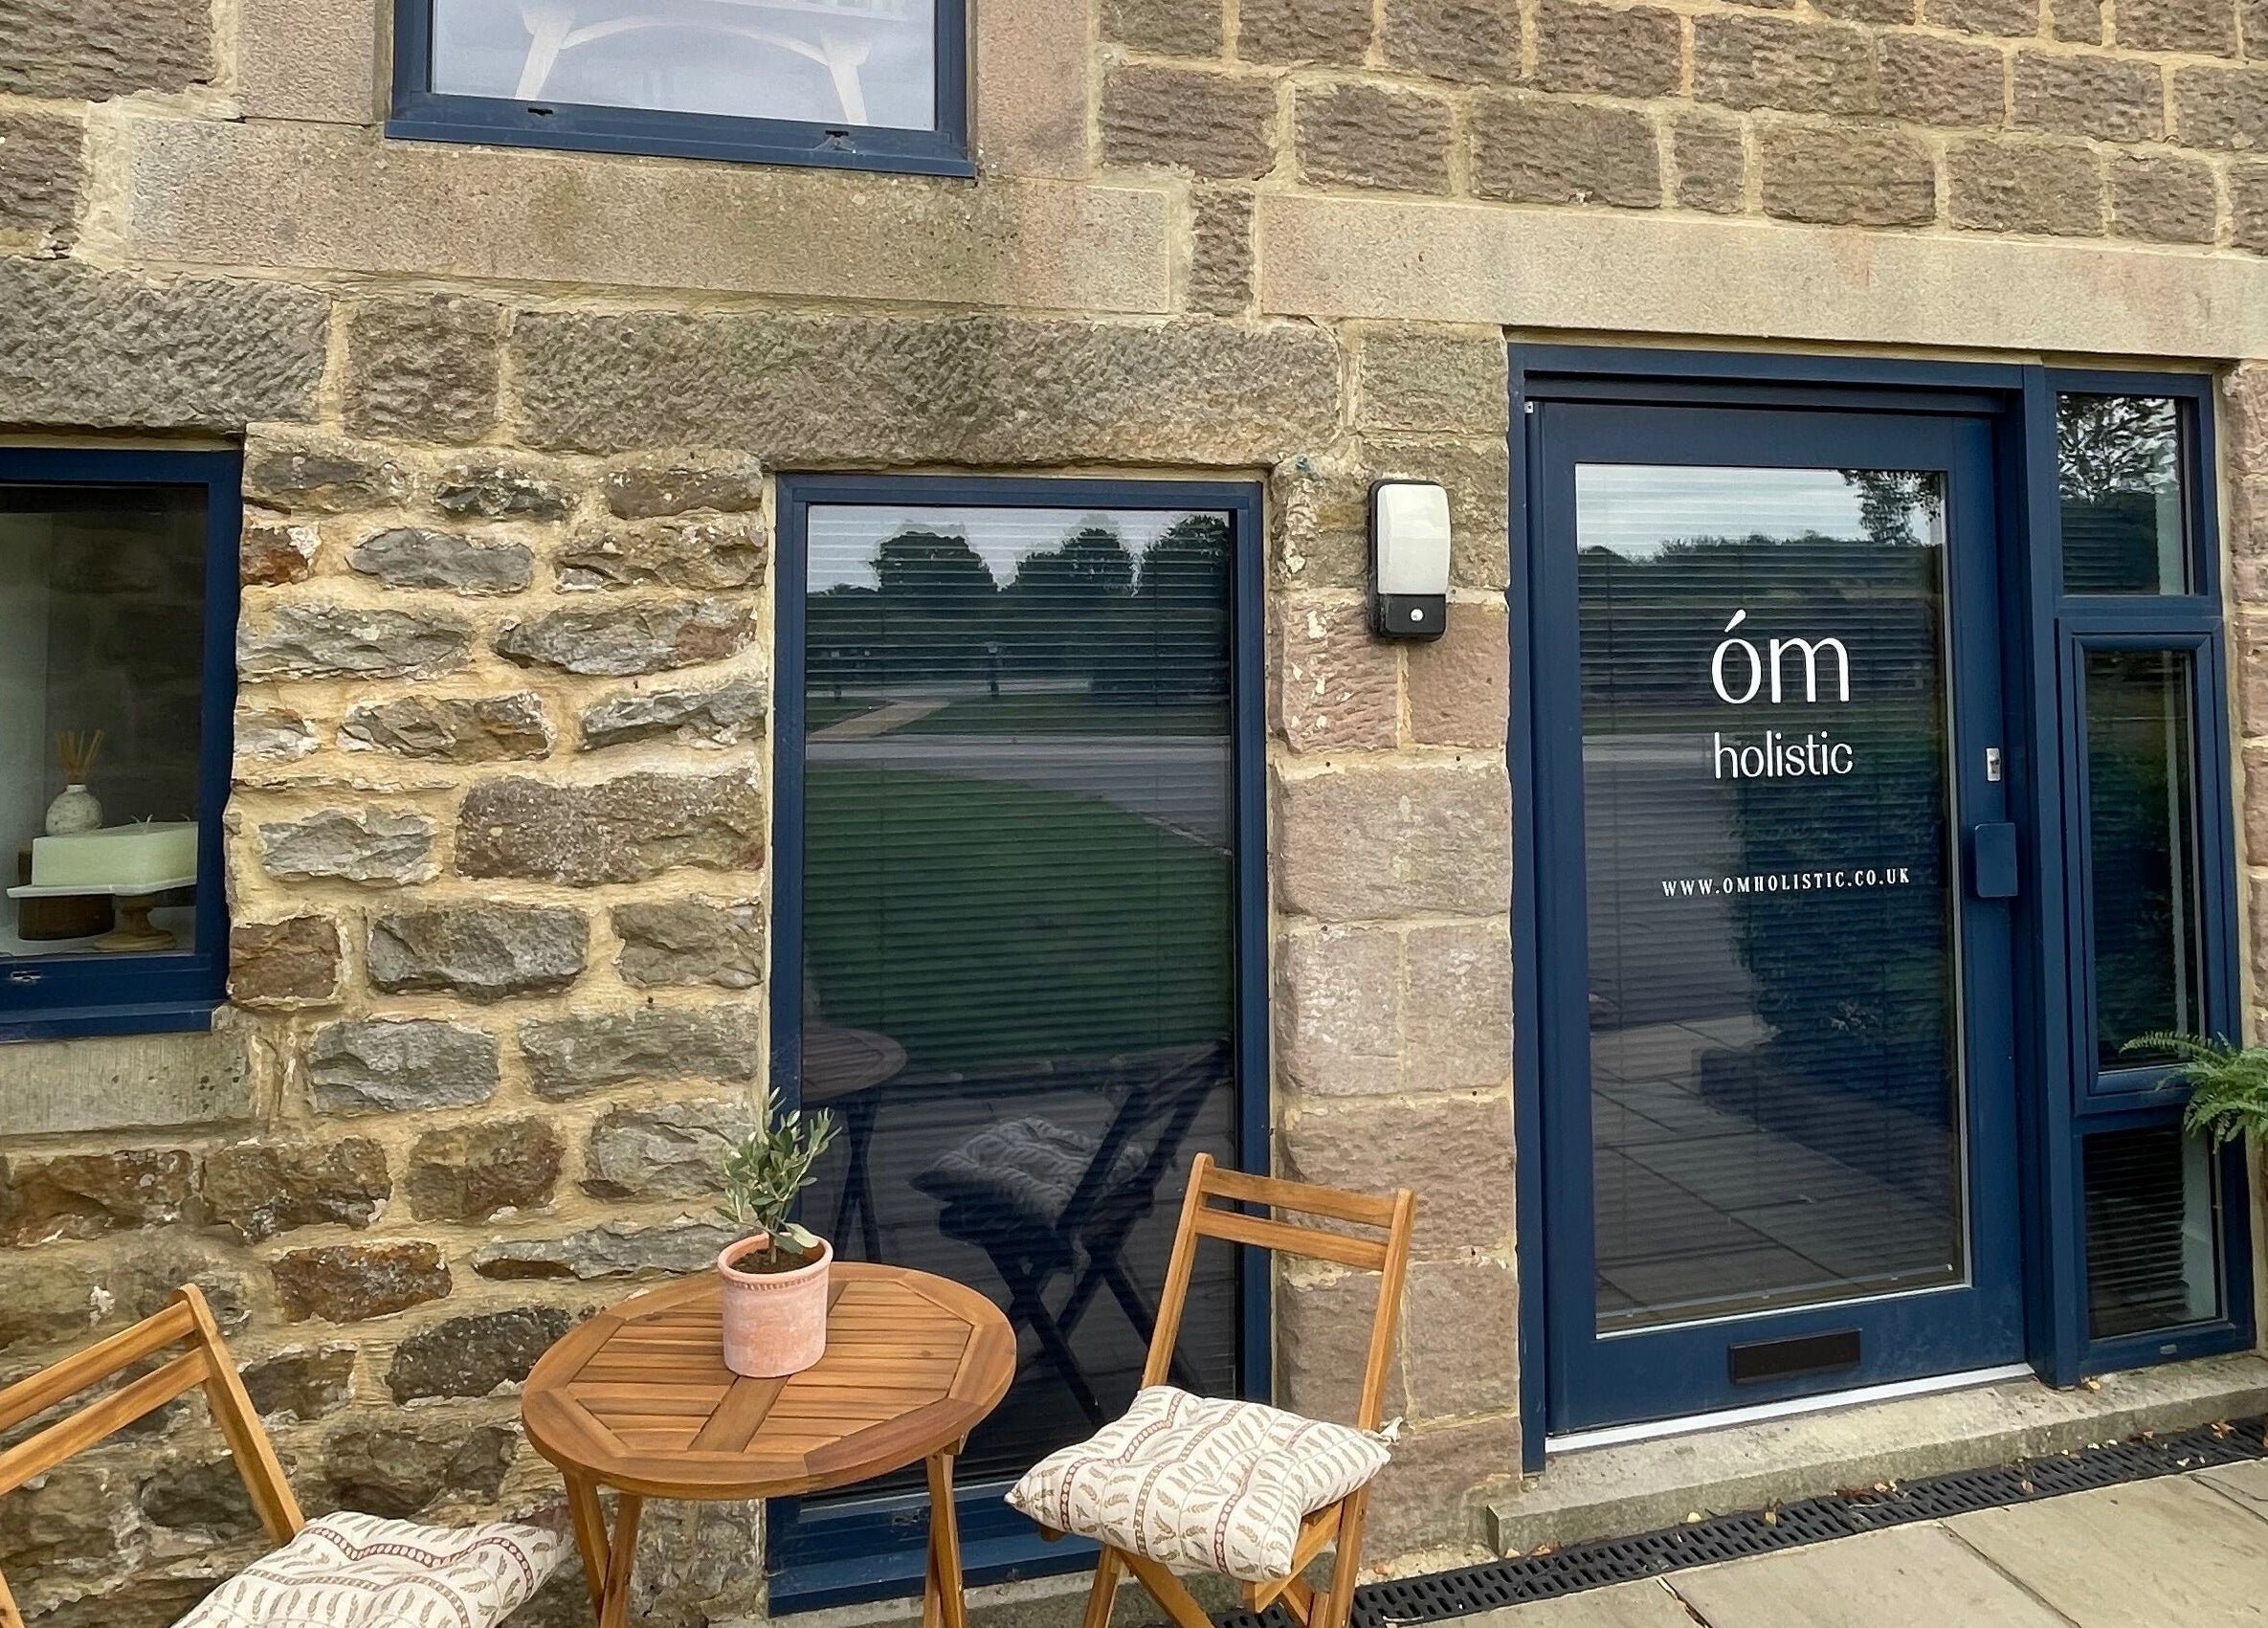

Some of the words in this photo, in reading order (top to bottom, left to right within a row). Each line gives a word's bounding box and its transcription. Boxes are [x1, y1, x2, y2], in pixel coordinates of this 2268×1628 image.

[1711, 609, 1850, 704] óm
[1714, 729, 1854, 779] holistic
[1661, 867, 1909, 897] WWW.OMHOLISTIC.CO.UK
